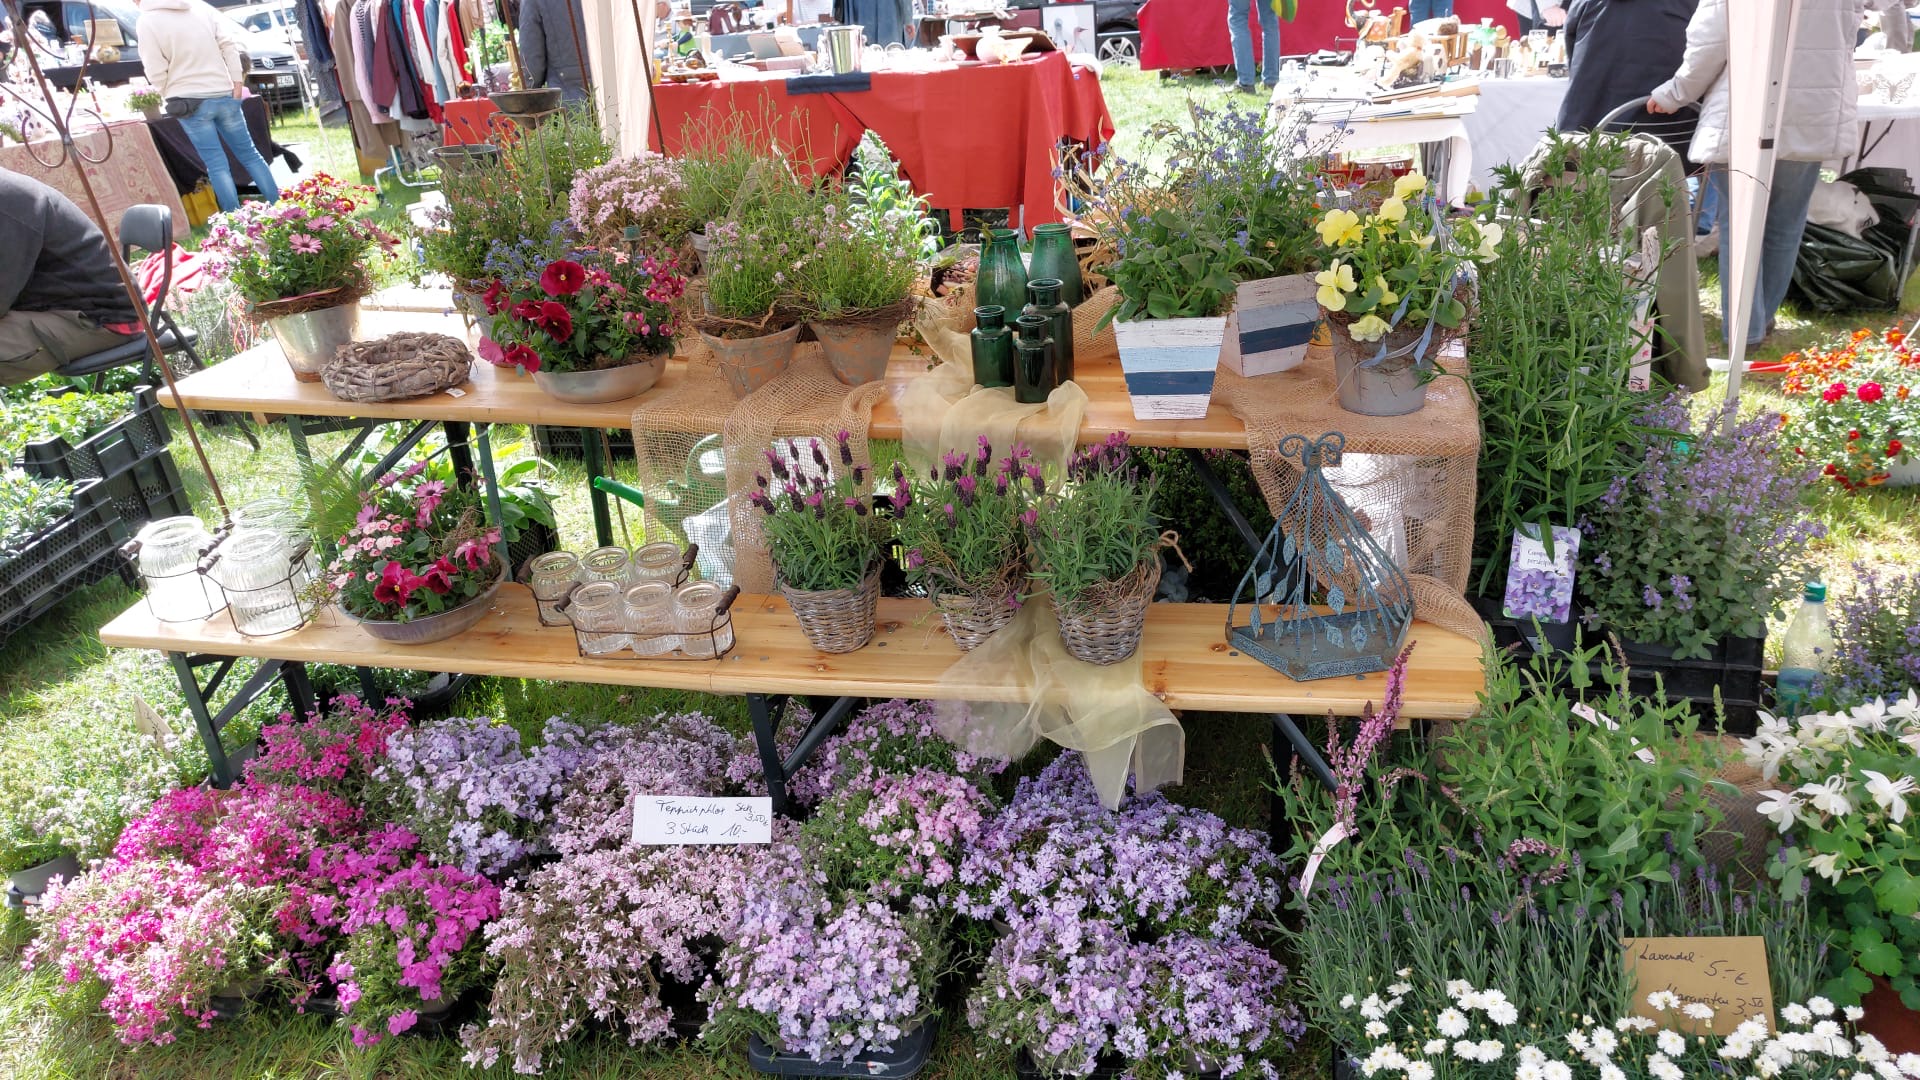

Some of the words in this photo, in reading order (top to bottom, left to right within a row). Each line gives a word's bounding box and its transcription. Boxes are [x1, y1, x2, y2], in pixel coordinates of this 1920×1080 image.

[664, 821, 677, 835] 3
[680, 822, 709, 835] Stück
[1639, 944, 1695, 963] Lavendel
